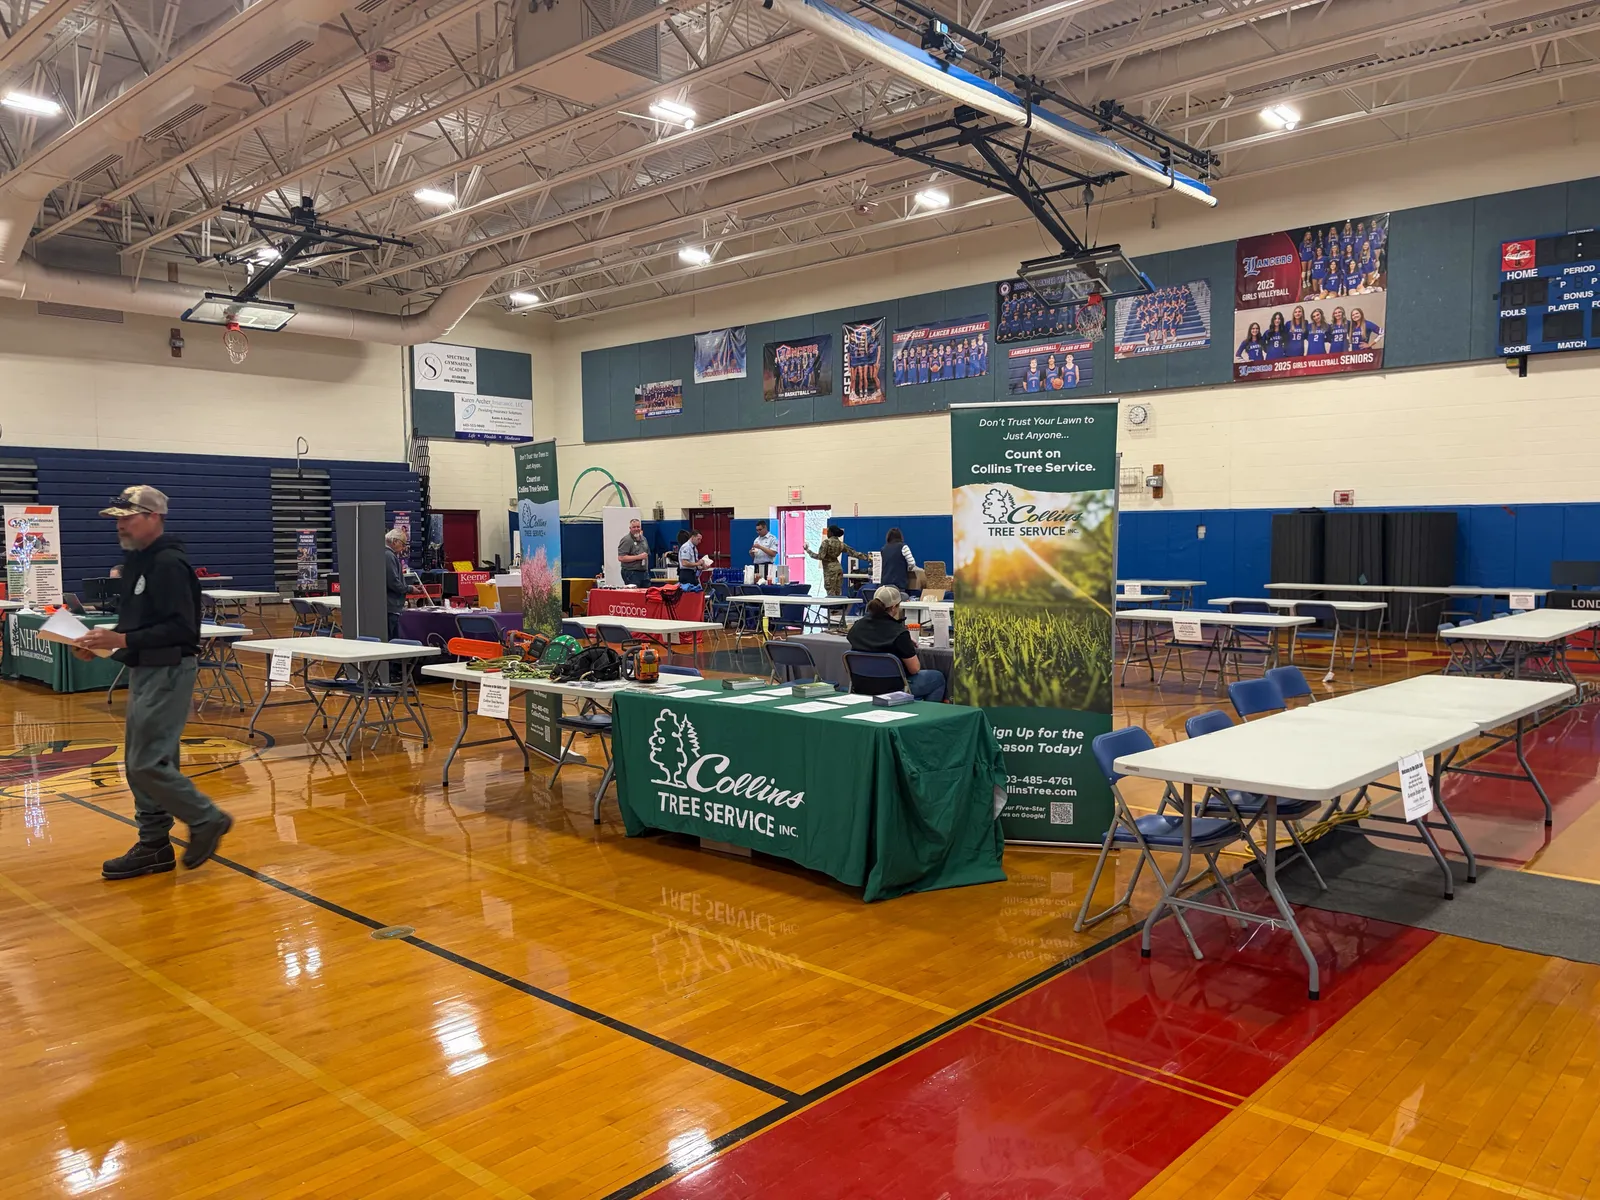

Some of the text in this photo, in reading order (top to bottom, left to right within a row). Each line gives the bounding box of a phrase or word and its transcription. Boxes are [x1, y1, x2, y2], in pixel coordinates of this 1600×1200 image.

[1242, 254, 1293, 278] LANCERS
[1564, 265, 1596, 275] PERIOD
[1506, 268, 1538, 280] HOME
[1257, 279, 1274, 290] 2025
[1242, 288, 1289, 301] GIRLS VOLLEYBALL
[1564, 290, 1594, 300] BONUS
[1500, 308, 1526, 317] FOULS
[1548, 303, 1579, 312] PLAYER
[929, 329, 949, 338] LANCER
[950, 323, 986, 334] BASKETBALL
[1161, 340, 1206, 350] CHEERLEADING
[1504, 345, 1531, 354] SCORE
[1558, 341, 1587, 349] MATCH
[1274, 361, 1291, 372] 2025
[1340, 353, 1374, 365] SENIORS
[979, 418, 1005, 427] Don't
[1034, 417, 1054, 425] Your
[1057, 416, 1081, 424] Lawn
[1003, 431, 1069, 441] Just Anyone...
[1005, 449, 1043, 460] Count
[971, 462, 1096, 474] Collins Tree Service.
[1007, 504, 1084, 525] Collins
[988, 527, 1014, 536] TREE
[1020, 526, 1065, 536] SERVICE
[460, 573, 488, 581] Keene
[609, 604, 647, 616] grappone
[992, 726, 1084, 740] ign Up for the
[1038, 743, 1083, 756] Today!
[686, 754, 805, 809] Collins
[658, 792, 799, 837] TREE SERVICE INC.
